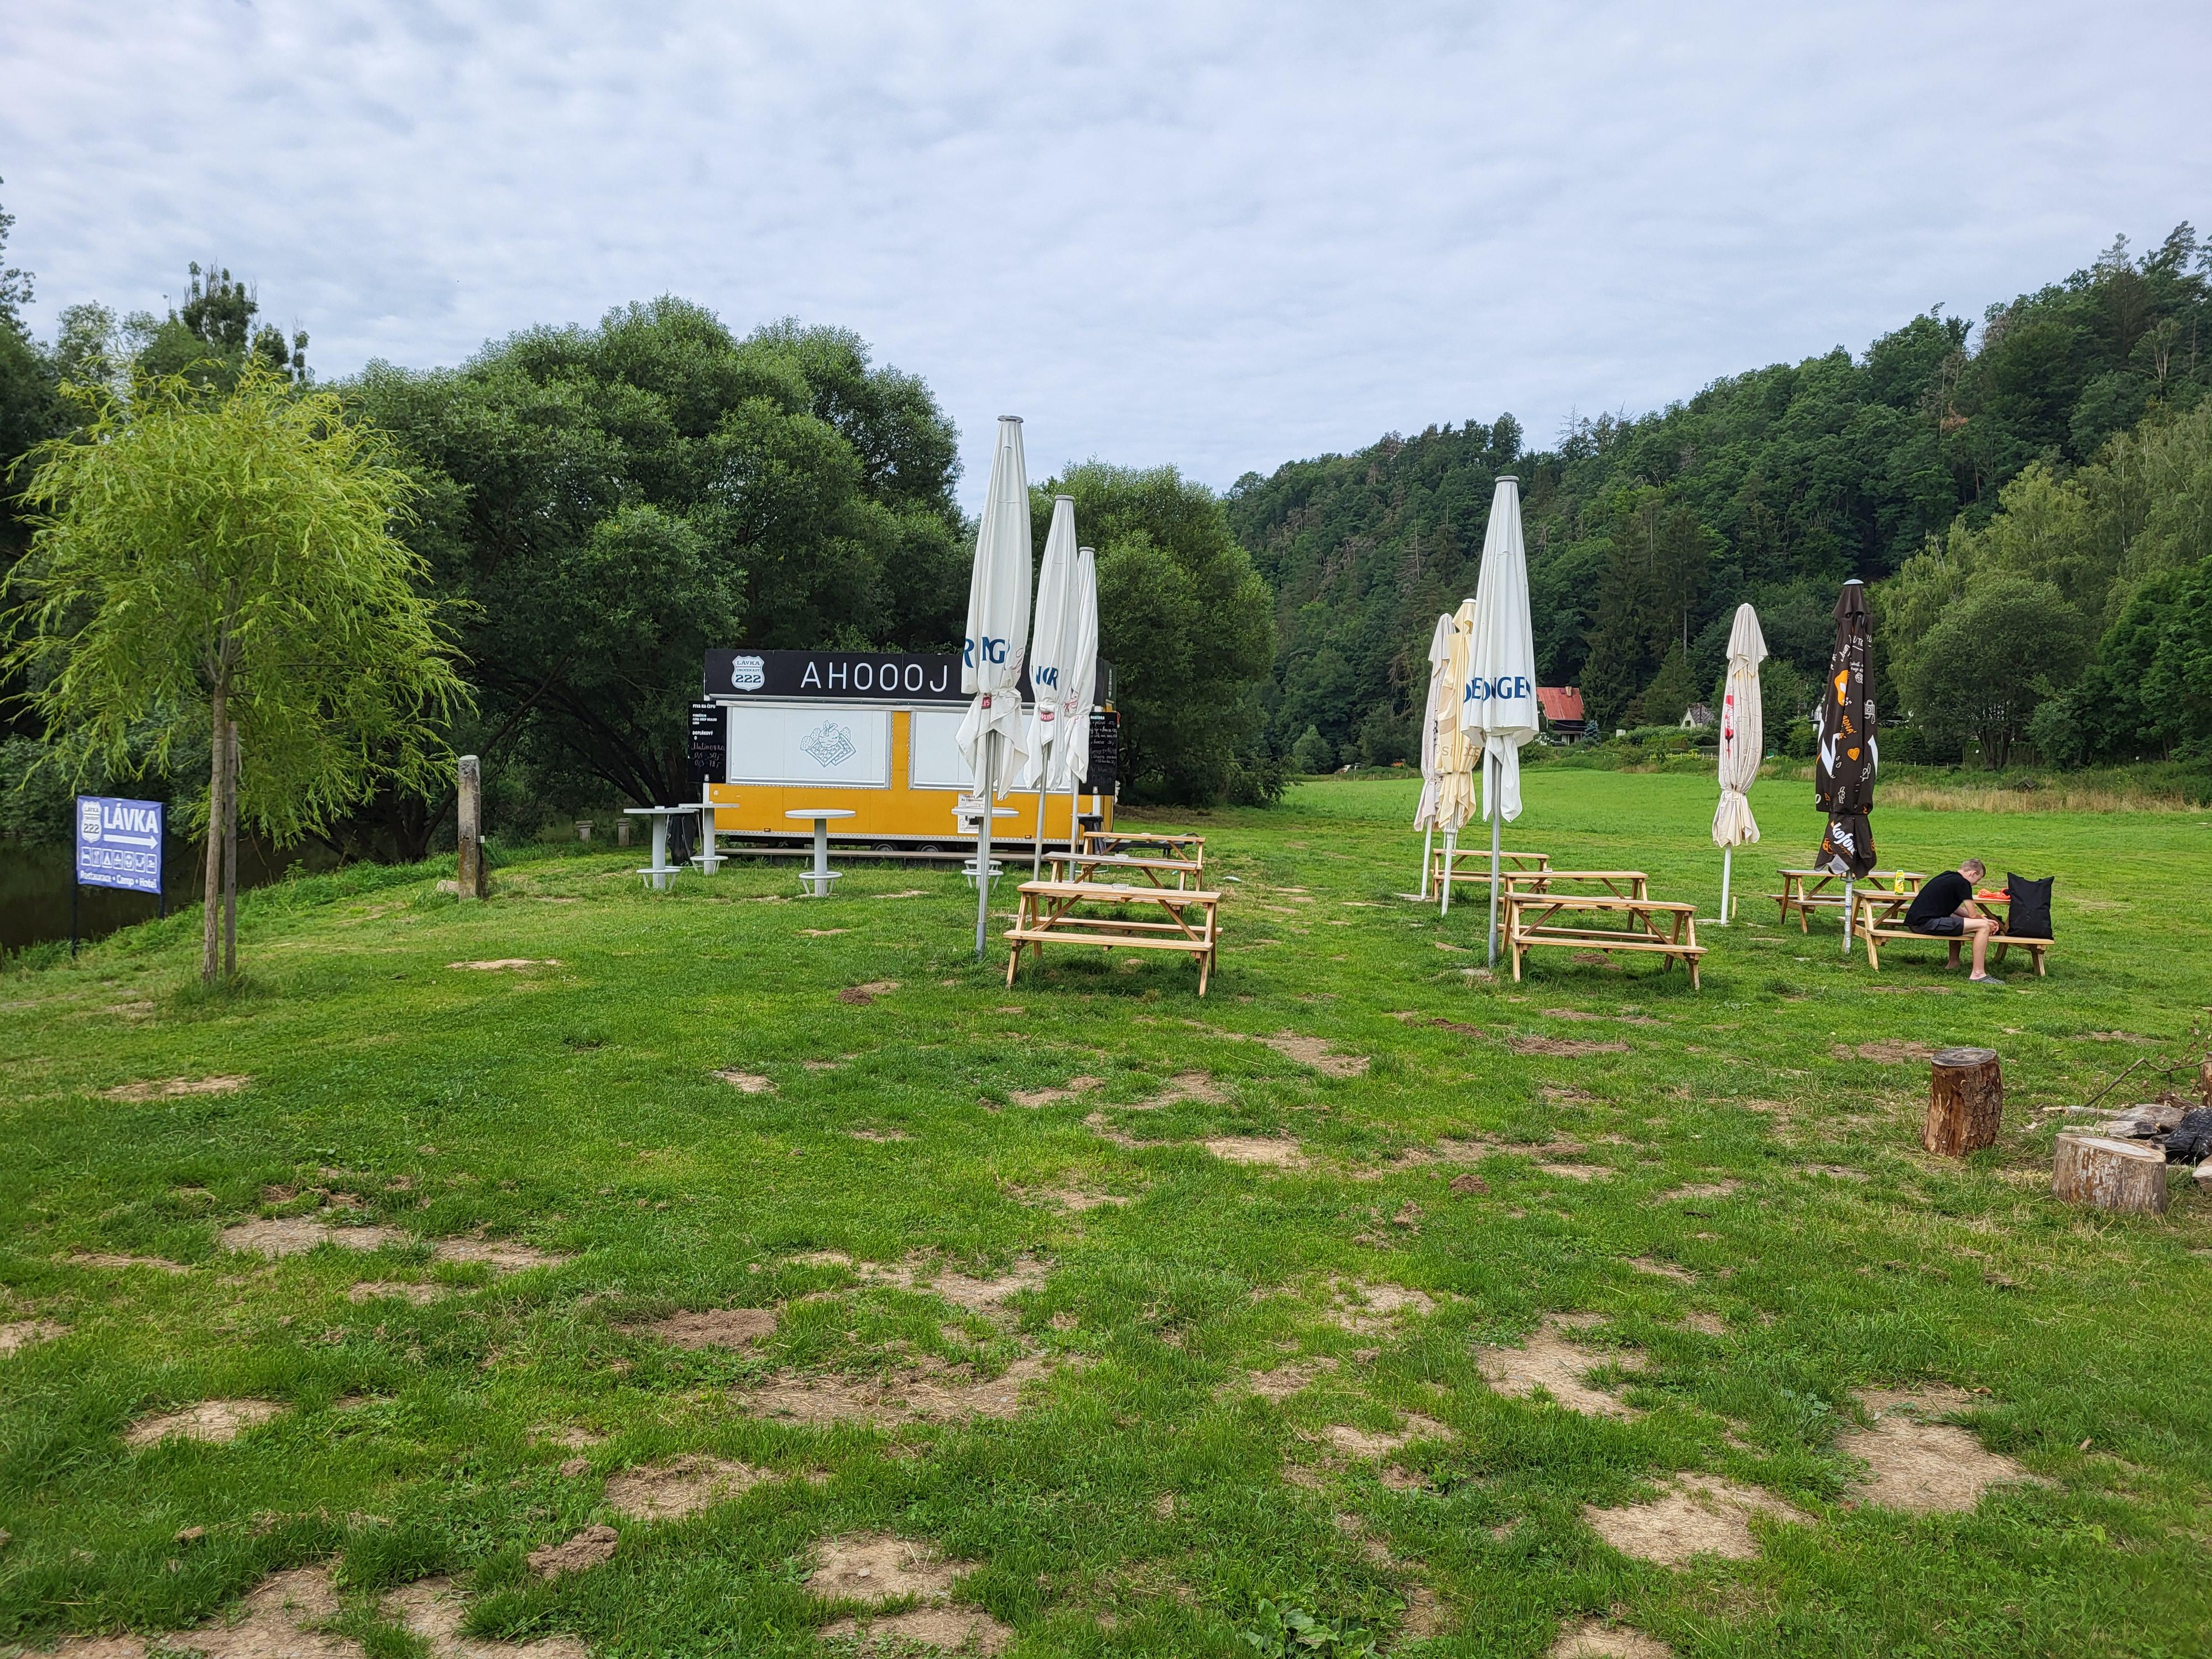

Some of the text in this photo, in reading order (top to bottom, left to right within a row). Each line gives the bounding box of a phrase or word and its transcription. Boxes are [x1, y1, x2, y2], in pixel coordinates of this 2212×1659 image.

[735, 675, 761, 683] 222
[801, 661, 947, 692] AHOOOJ
[103, 803, 159, 833] LÁVKA
[83, 823, 100, 834] 222
[116, 874, 134, 887] Camp
